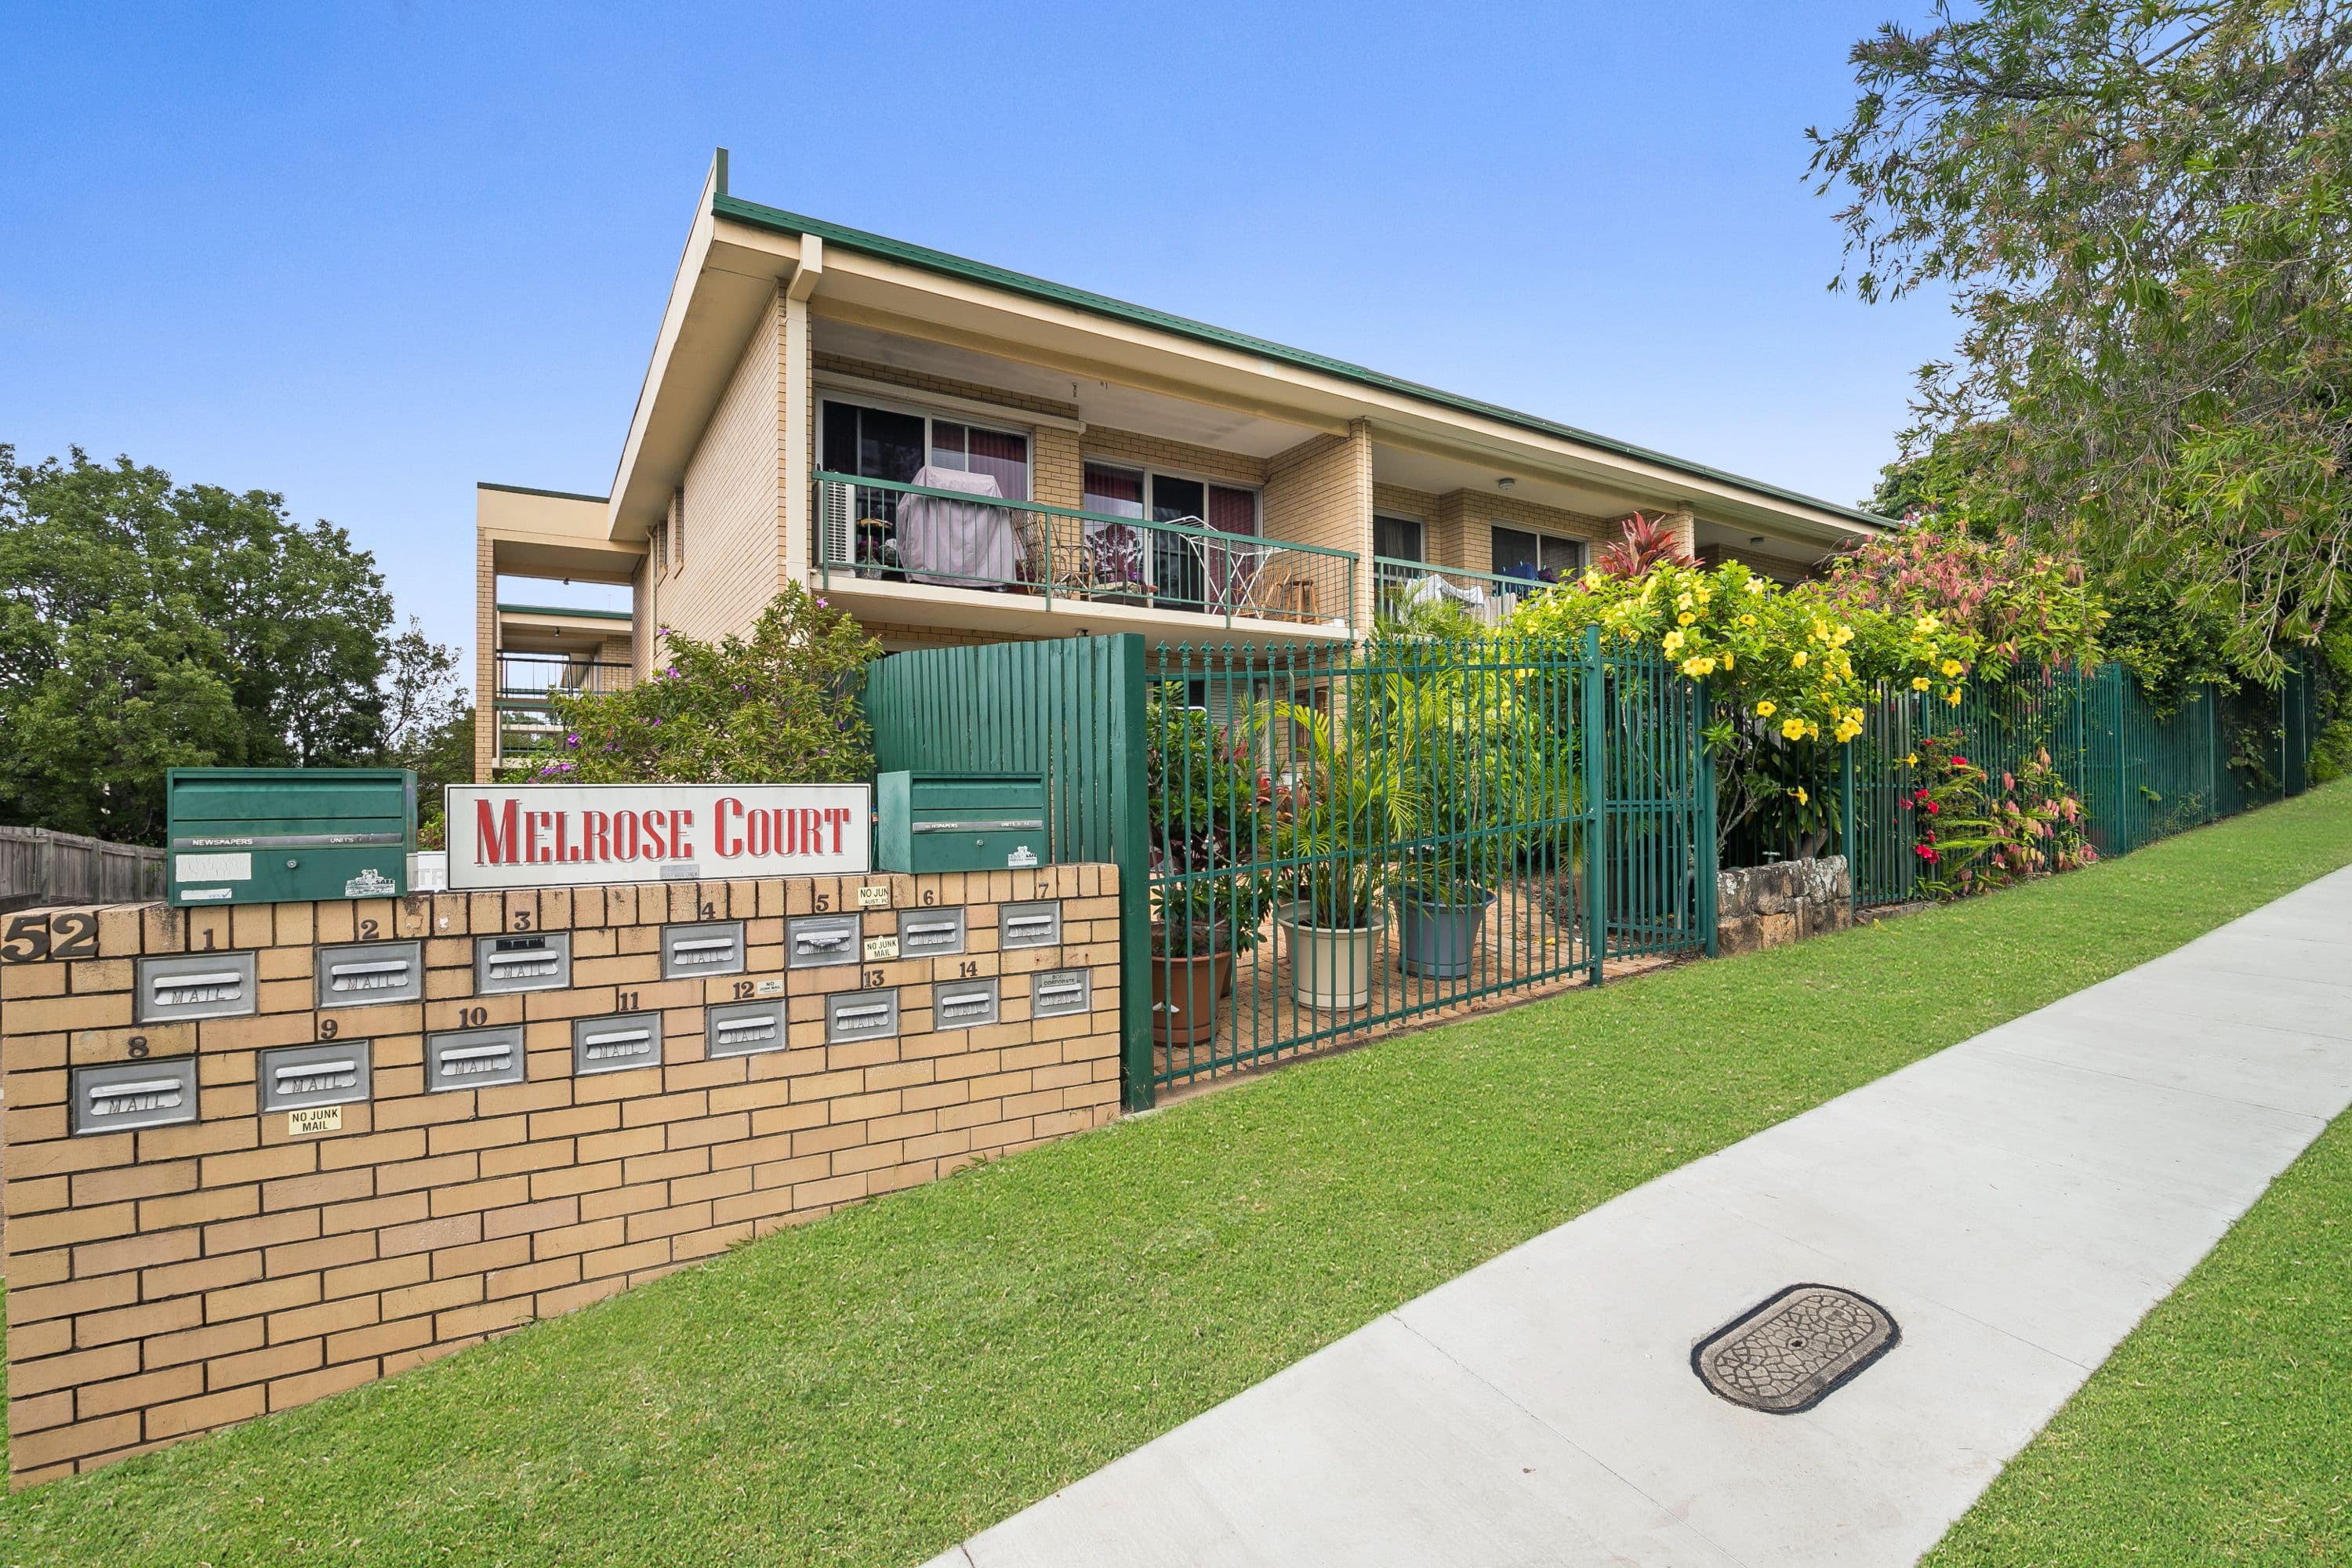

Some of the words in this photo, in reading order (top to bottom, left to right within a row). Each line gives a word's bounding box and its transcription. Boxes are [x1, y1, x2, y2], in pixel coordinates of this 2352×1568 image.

[474, 798, 696, 866] MELROSE
[714, 797, 851, 859] COURT
[860, 888, 872, 898] NO
[923, 889, 934, 906] 6
[1038, 881, 1049, 898] 7
[702, 902, 716, 919] 4
[815, 895, 829, 911] 5
[361, 919, 379, 939] 2
[514, 911, 531, 931] 3
[1, 913, 100, 962] 52
[202, 928, 216, 950] 1
[867, 942, 877, 951] NO
[878, 940, 897, 949] JUNK
[685, 950, 724, 964] MAIL
[874, 949, 891, 958] MAIL
[502, 964, 546, 978] MAIL
[959, 960, 978, 978] 14
[346, 975, 395, 991] MAIL
[864, 969, 884, 988] 13
[1044, 978, 1075, 986] CORPORATE
[171, 987, 226, 1004] MAIL
[732, 981, 755, 1000] 12
[619, 991, 640, 1011] 11
[459, 1007, 488, 1029] 10
[320, 1018, 338, 1040] 9
[728, 1028, 767, 1043] MAIL
[128, 1036, 149, 1058] 8
[598, 1043, 639, 1058] MAIL
[455, 1058, 500, 1075] MAIL
[292, 1074, 343, 1093] MAIL
[108, 1094, 165, 1113] MAIL
[292, 1112, 307, 1123] NO
[310, 1108, 339, 1120] JUNK
[302, 1120, 328, 1132] MAIL
